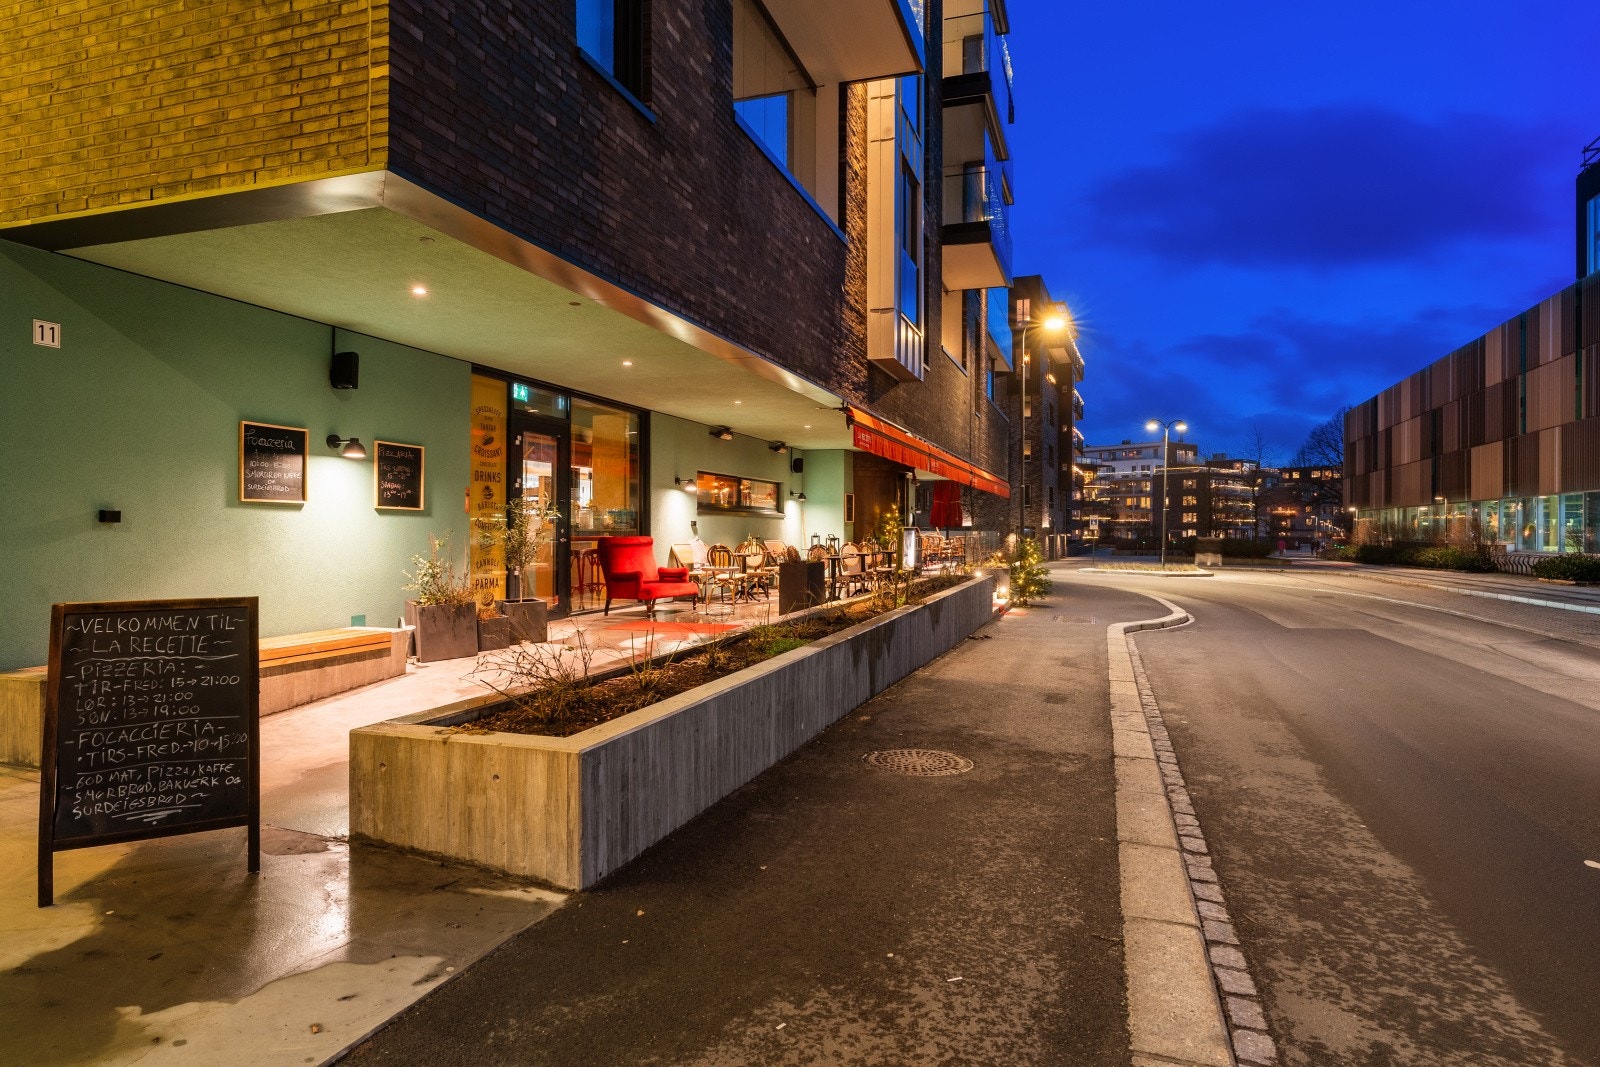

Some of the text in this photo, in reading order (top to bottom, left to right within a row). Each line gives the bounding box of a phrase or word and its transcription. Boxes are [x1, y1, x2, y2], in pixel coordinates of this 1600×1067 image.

[38, 324, 55, 344] 11
[474, 470, 501, 483] DRINKS
[476, 578, 500, 590] PARMA
[81, 616, 200, 634] VELKOMMEN
[92, 634, 210, 654] LA RECETTE
[200, 676, 240, 686] 21:00
[152, 692, 194, 702] 21:00
[154, 705, 200, 716] 19:00
[198, 764, 235, 775] KAFFE
